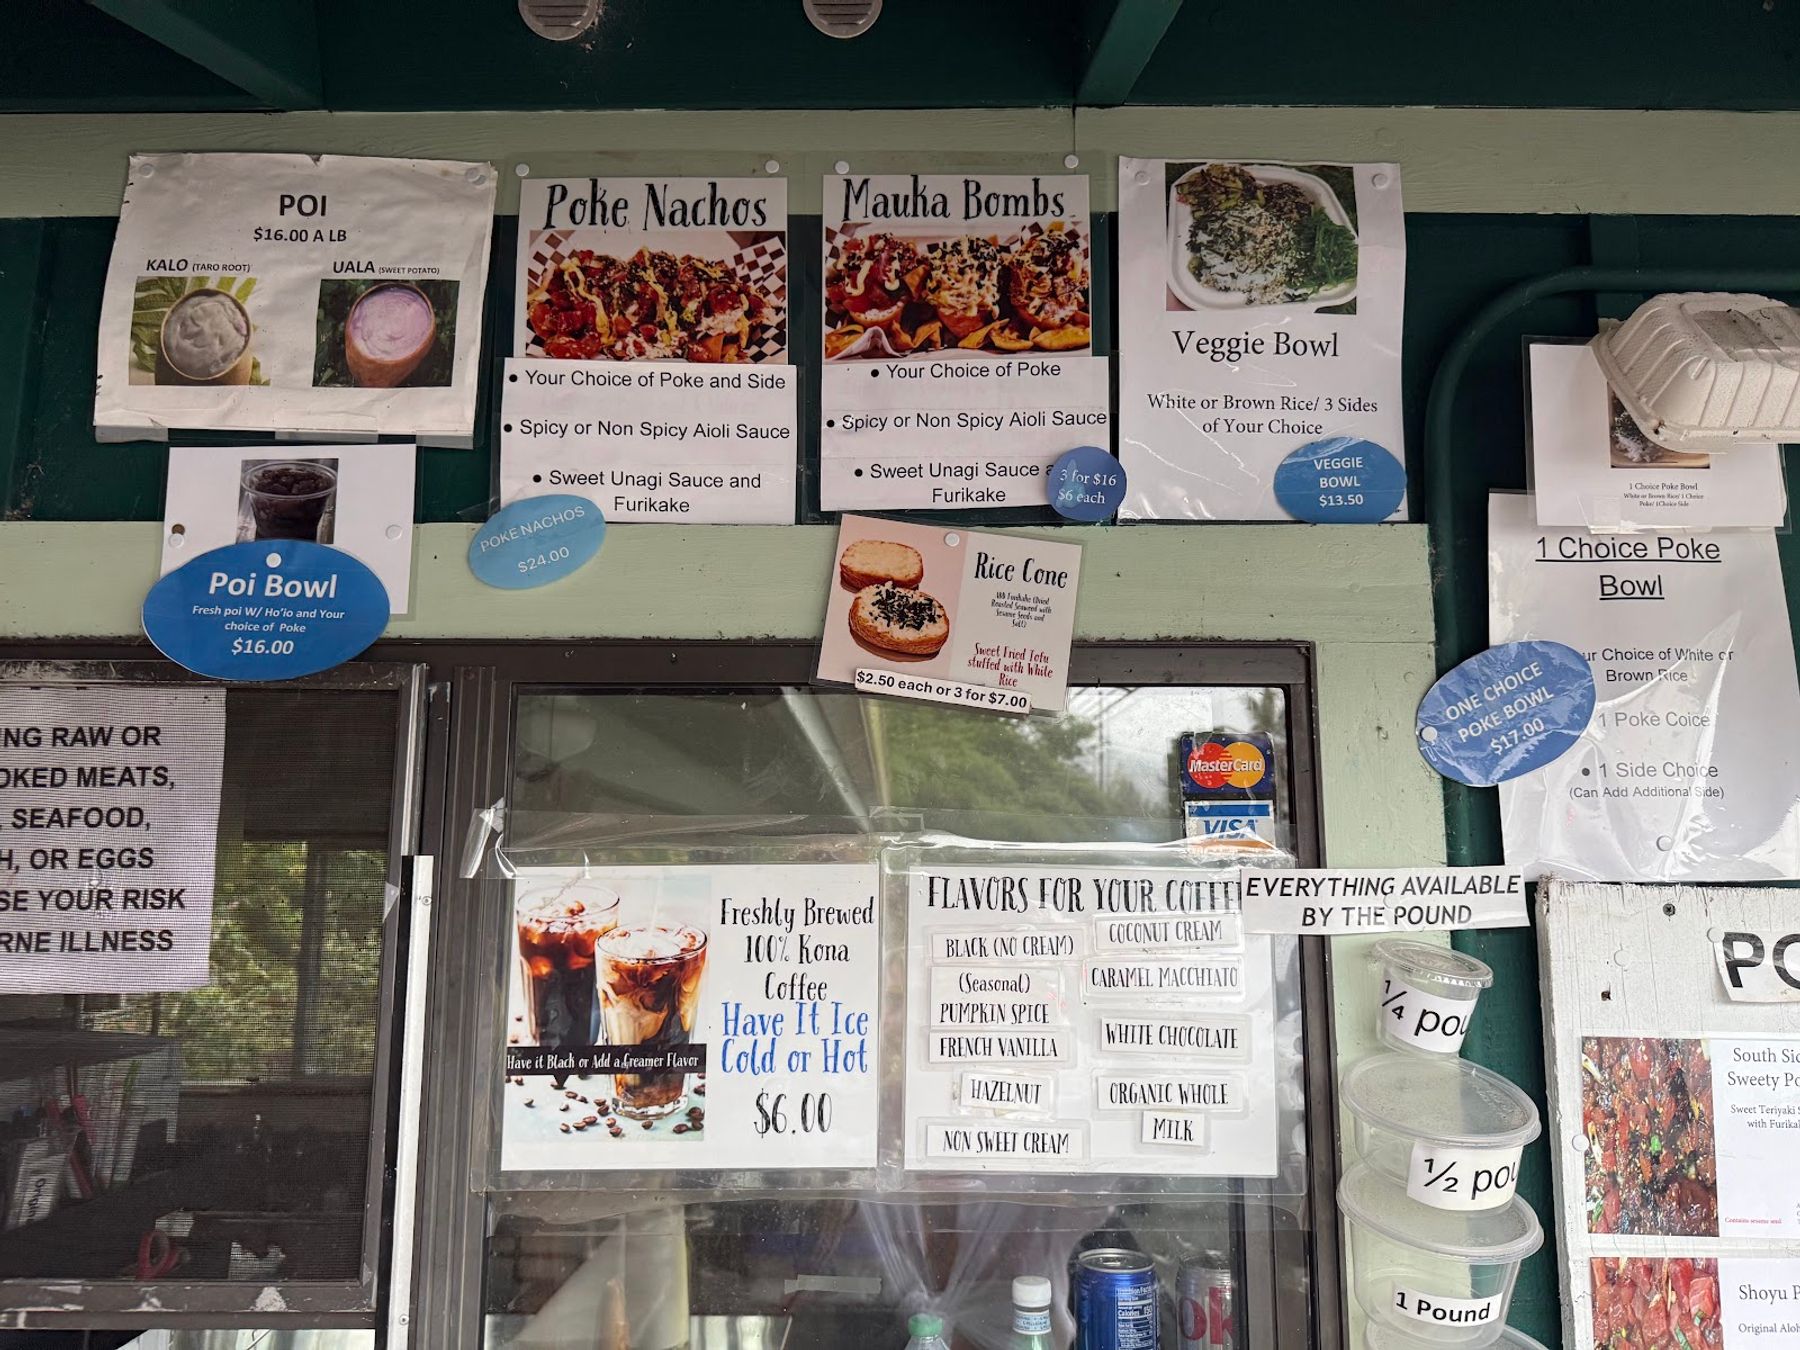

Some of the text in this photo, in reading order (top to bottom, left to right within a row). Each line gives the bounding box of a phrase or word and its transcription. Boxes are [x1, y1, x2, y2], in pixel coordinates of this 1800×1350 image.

[279, 194, 326, 218] POI
[543, 178, 767, 230] Poke Nachos
[842, 175, 1065, 222] Mauka Bombs
[253, 227, 347, 242] $16.00 A LB
[146, 258, 250, 273] KALO (TARO ROOT)
[333, 260, 440, 276] UALA (SWEET POTATO)
[1172, 331, 1339, 363] Veggie Bowl
[886, 361, 1061, 379] Your Choice of Poke
[1147, 394, 1378, 412] White or Brown Rice/ 3 Sides
[520, 419, 790, 440] Spicy or Non Spicy Aioli Sauce
[1314, 457, 1363, 470] VEGGIE
[549, 470, 761, 490] Sweet Unagi Sauce and
[1060, 469, 1117, 486] 3 for $16
[1319, 476, 1360, 488] BOWL
[1634, 482, 1660, 490] Choice
[1661, 482, 1679, 490] Poke
[1680, 482, 1698, 490] Bowl
[614, 496, 690, 513] Furikake
[1058, 488, 1105, 504] $6 each
[1319, 494, 1364, 507] $13.50
[480, 506, 586, 553] POKE NACHOS
[1537, 536, 1721, 559] 1 Choice Poke
[517, 546, 570, 574] $24.00
[974, 552, 1068, 589] Rice Cone
[209, 572, 338, 599] Poi Bowl
[1600, 575, 1664, 597] Bowl
[192, 605, 222, 616] Fresh
[224, 607, 242, 618] poi
[244, 607, 263, 618] W/
[296, 609, 317, 618] and
[319, 609, 345, 619] Your
[224, 621, 306, 633] choice of Poke
[231, 637, 294, 656] $16.00
[974, 642, 1050, 664] Sweet Fried Tofu
[967, 656, 1053, 678] stuffed with White
[857, 671, 1027, 709] $2.50 each or 3 for $7.00
[999, 672, 1018, 687] Rice
[1445, 662, 1543, 722] ONE CHOICE
[1457, 688, 1554, 744] POKE BOWL
[1599, 712, 1711, 727] 1 Poke Coice
[51, 726, 162, 747] RAW OR
[1490, 717, 1546, 754] $17.00
[1189, 759, 1263, 772] MasterCard
[76, 766, 175, 791] MEATS,
[11, 806, 151, 830] SEAFOOD,
[1204, 819, 1257, 838] VISA
[927, 876, 1028, 914] FLAVORS
[1038, 876, 1085, 913] FOR
[1092, 877, 1157, 914] YOUR
[1246, 874, 1521, 898] EVERYTHING AVAILABLE
[38, 887, 186, 911] YOUR RISK
[720, 896, 875, 932] Freshly Brewed
[1302, 905, 1472, 927] BY THE POUND
[60, 930, 174, 952] ILLNESS
[1109, 920, 1222, 944] COCONUT CREAM
[743, 933, 850, 964] 100% Kona
[945, 935, 1074, 958] BLACK (NO CREAM)
[765, 972, 828, 1001] Coffee
[958, 971, 1031, 994] (Seasonal)
[1091, 967, 1238, 988] CARAMEL MACCHIATO
[940, 1002, 1050, 1024] PUMPKIN SPICE
[1106, 1023, 1238, 1049] WHITE CHOCOLATE
[940, 1037, 1058, 1058] FRENCH VANILLA
[1733, 1047, 1777, 1062] South
[507, 1053, 699, 1069] Have it Black or Add a Creamer Flavor
[970, 1079, 1042, 1104] HAZELNUT
[1728, 1071, 1780, 1091] Sweety
[1109, 1082, 1228, 1104] ORGANIC WHOLE
[754, 1087, 833, 1138] $6.00
[1730, 1104, 1796, 1117] Sweet Teriyaki
[1152, 1118, 1194, 1142] MILK
[1747, 1119, 1767, 1129] with
[1739, 1284, 1787, 1305] Shoyu
[1396, 1292, 1491, 1324] 1 Pound
[1738, 1323, 1777, 1336] Original
